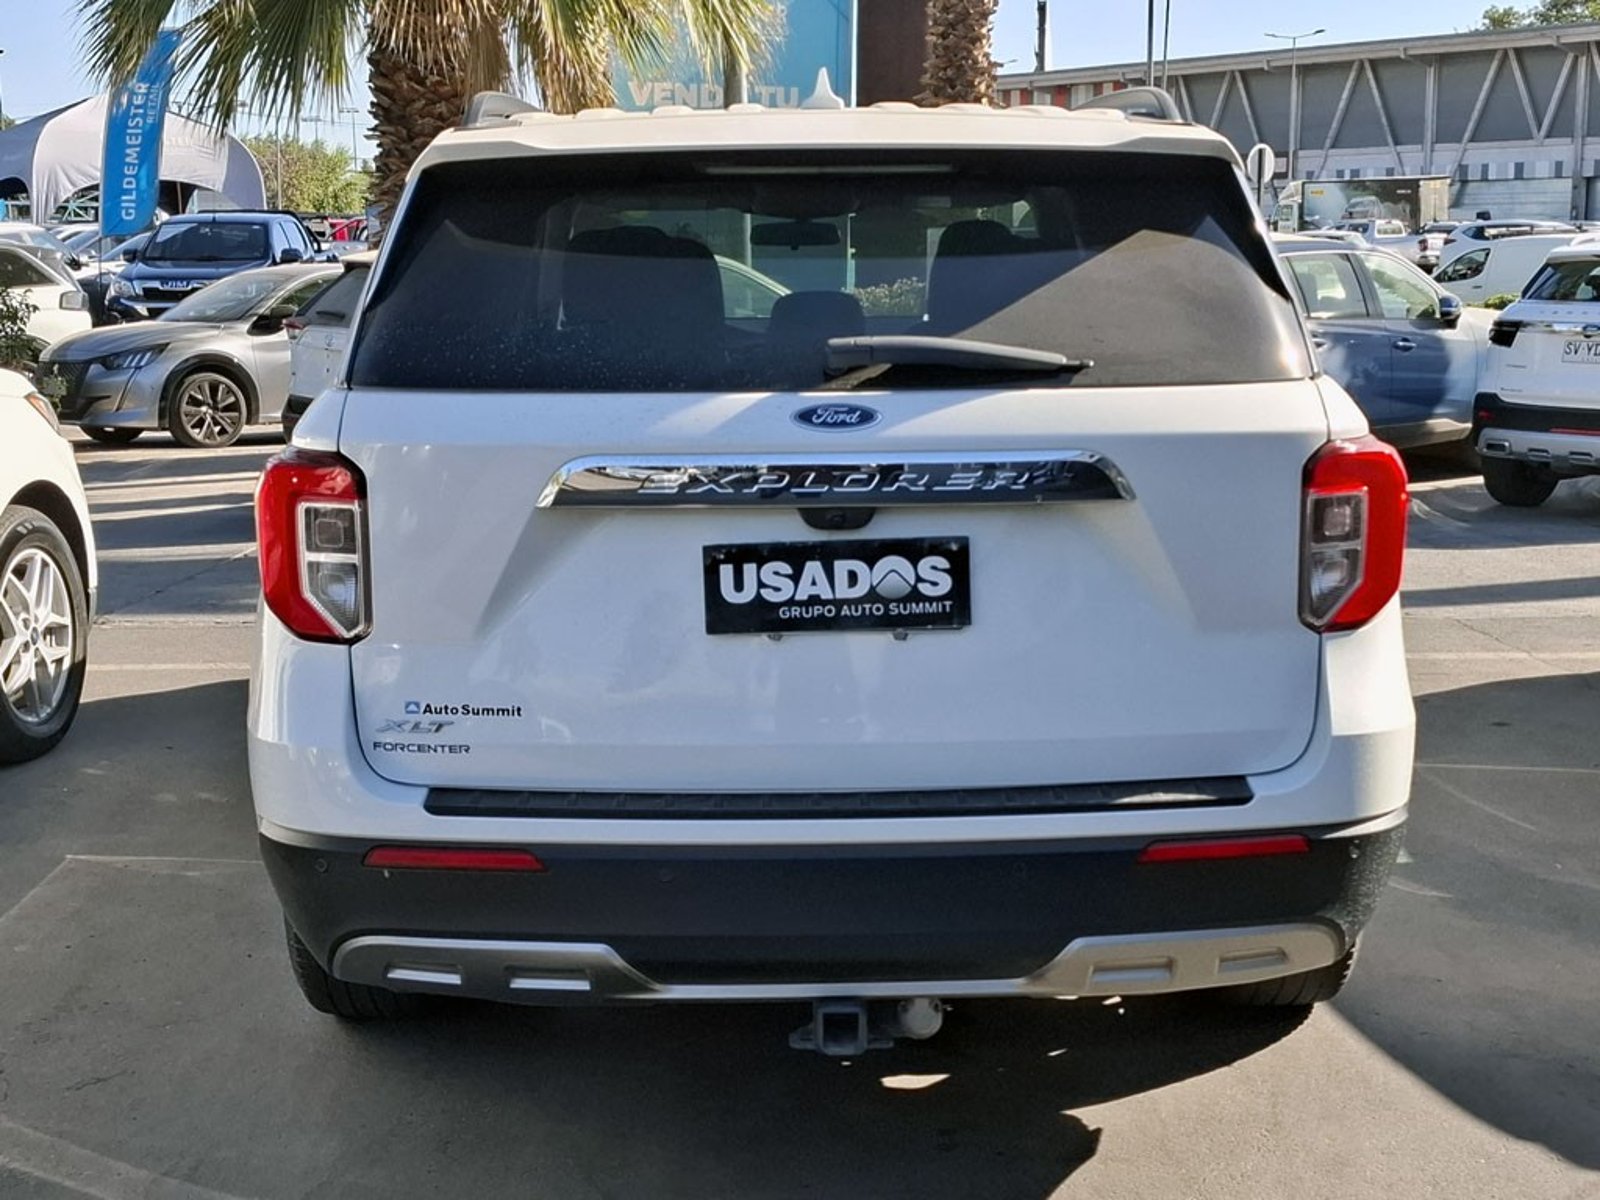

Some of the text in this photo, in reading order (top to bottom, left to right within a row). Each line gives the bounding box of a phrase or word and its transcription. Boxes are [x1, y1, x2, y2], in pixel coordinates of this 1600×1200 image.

[146, 82, 160, 124] RETAIL
[628, 81, 800, 108] VEND TU
[121, 82, 150, 221] GILDEMEISTER
[811, 407, 861, 424] Ford
[637, 471, 1030, 494] EXPLORER
[719, 554, 953, 604] USADOS
[779, 601, 953, 619] GRUPO AUTO SUMMIT
[375, 719, 455, 733] XLT
[373, 741, 471, 754] FORCENTER
